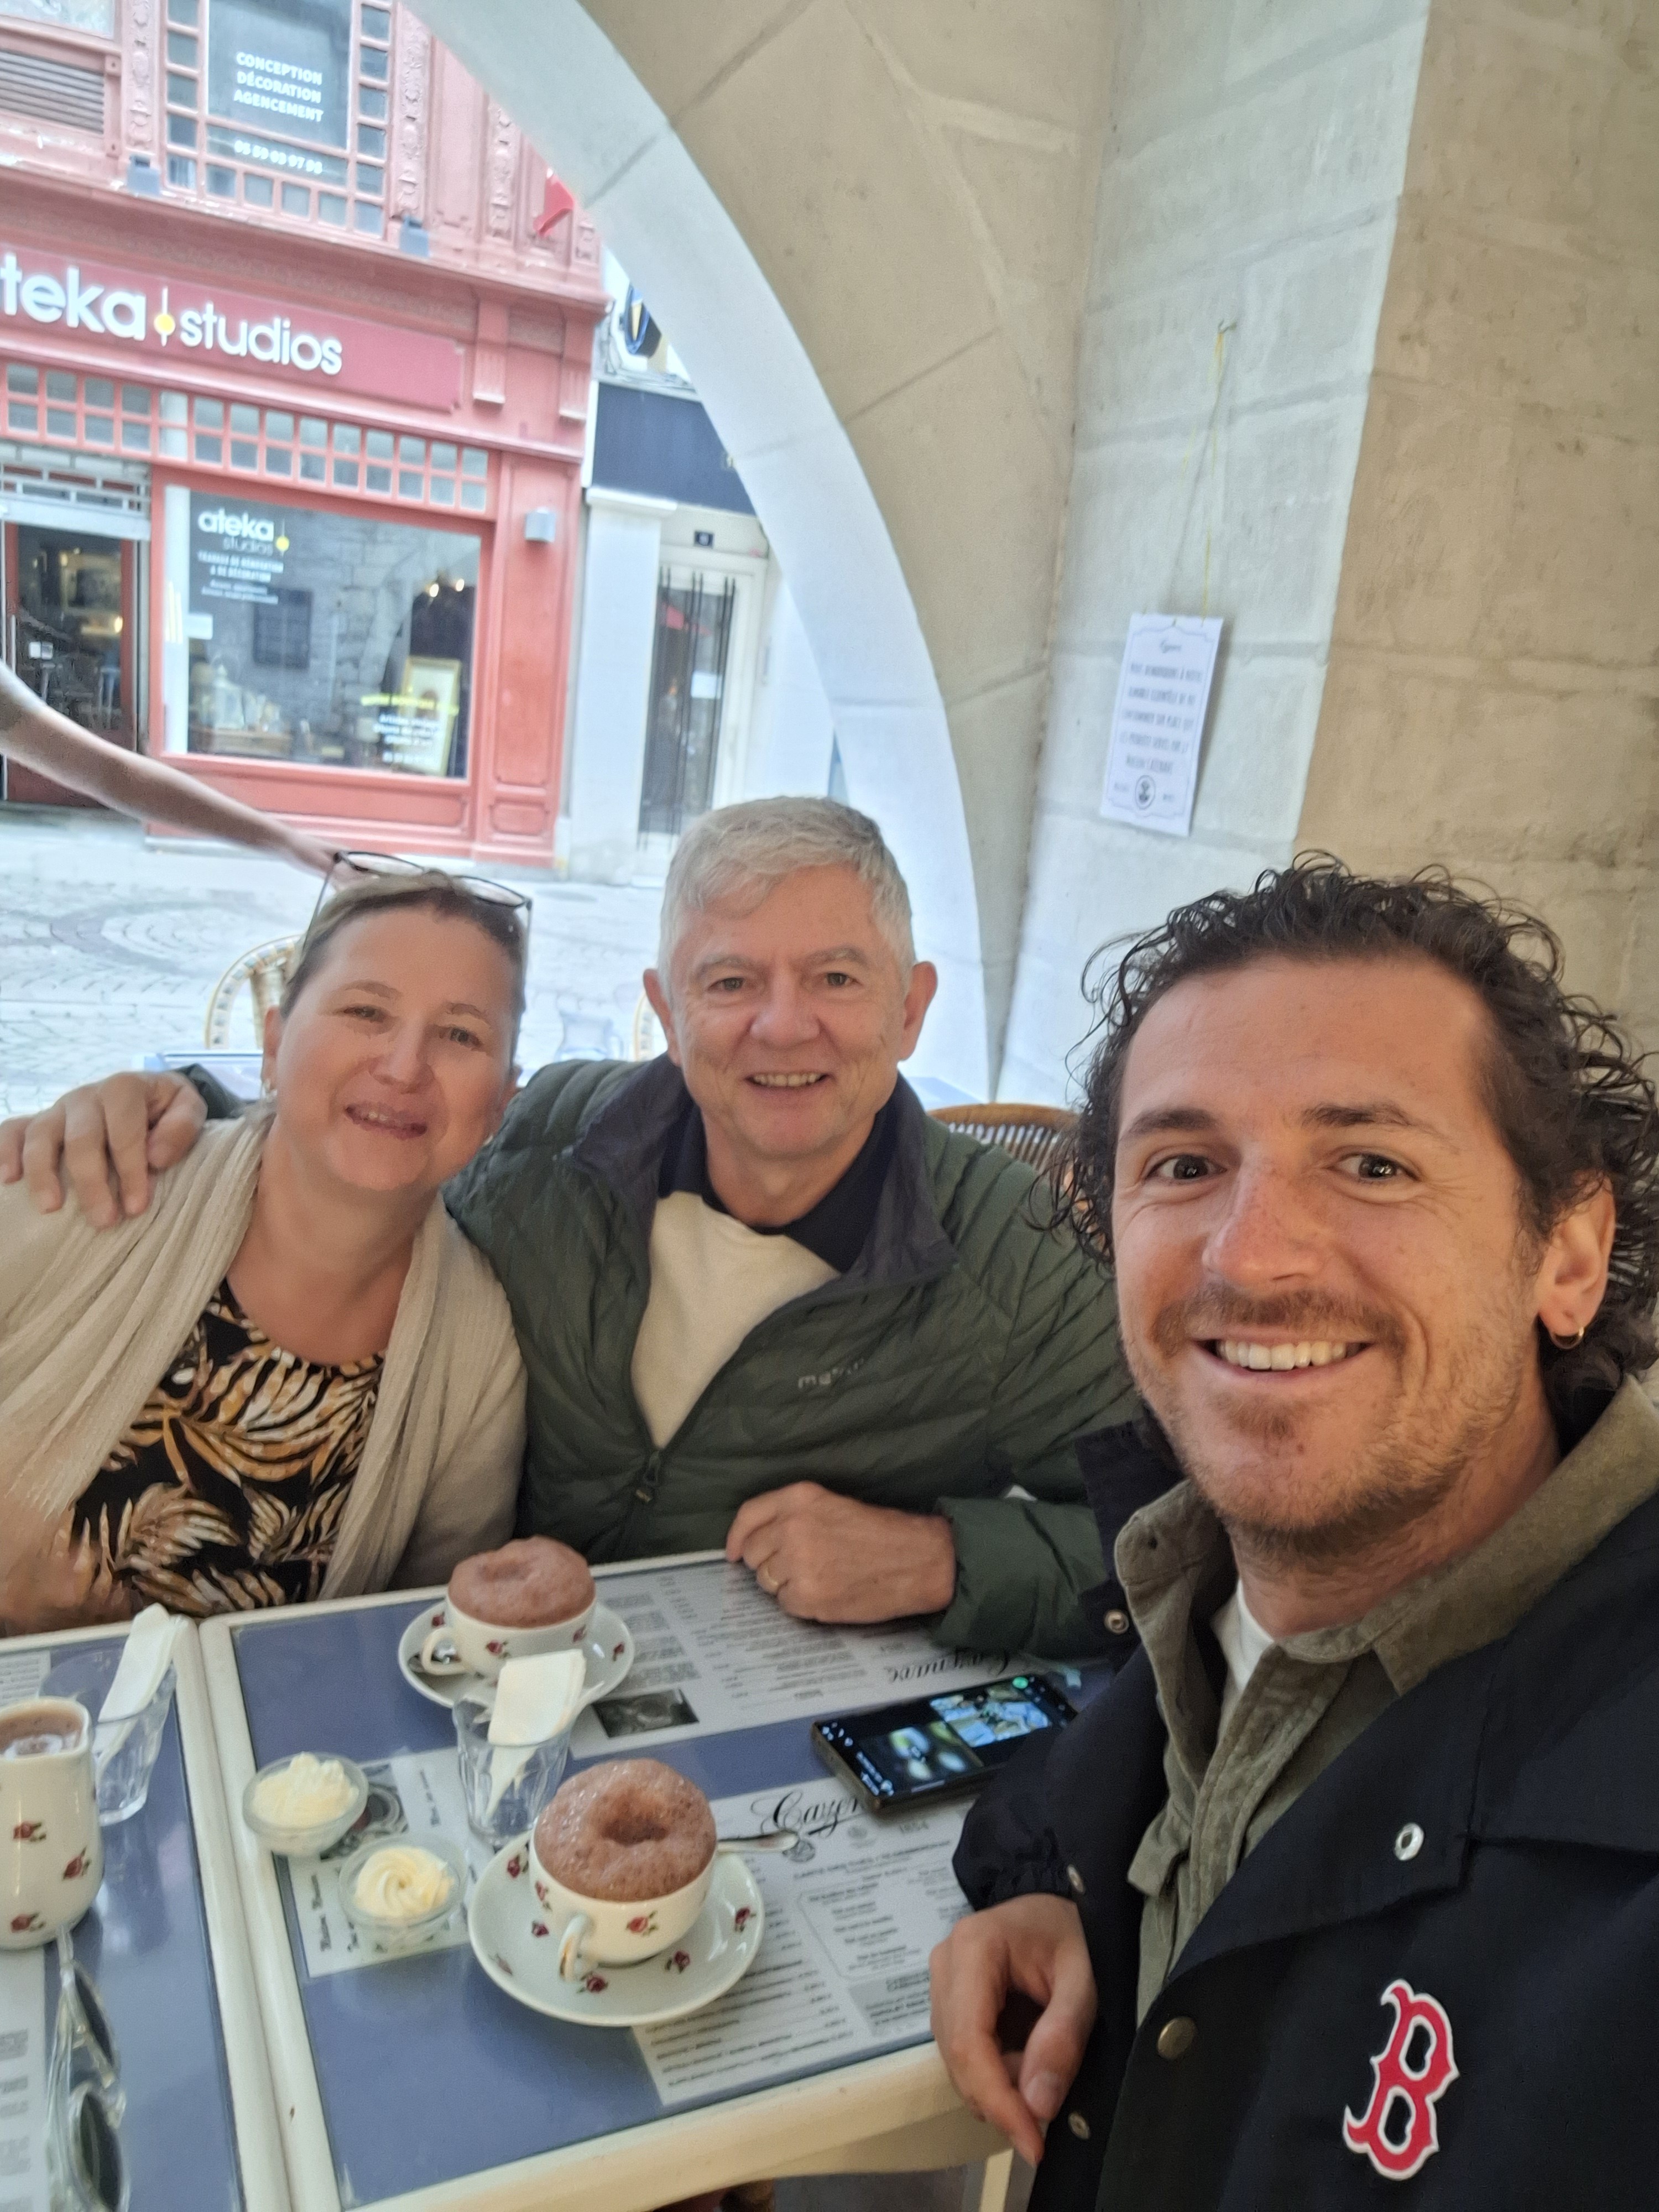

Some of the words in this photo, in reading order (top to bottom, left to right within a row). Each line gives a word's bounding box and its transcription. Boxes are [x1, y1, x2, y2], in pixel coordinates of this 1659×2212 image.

[237, 52, 322, 85] CONCEPTION
[237, 71, 321, 103] DÉCORATION
[234, 90, 324, 122] AGENCEMENT
[234, 140, 251, 155] 05
[180, 302, 343, 375] studios
[198, 507, 274, 542] ateka
[1342, 1978, 1460, 2181] B
